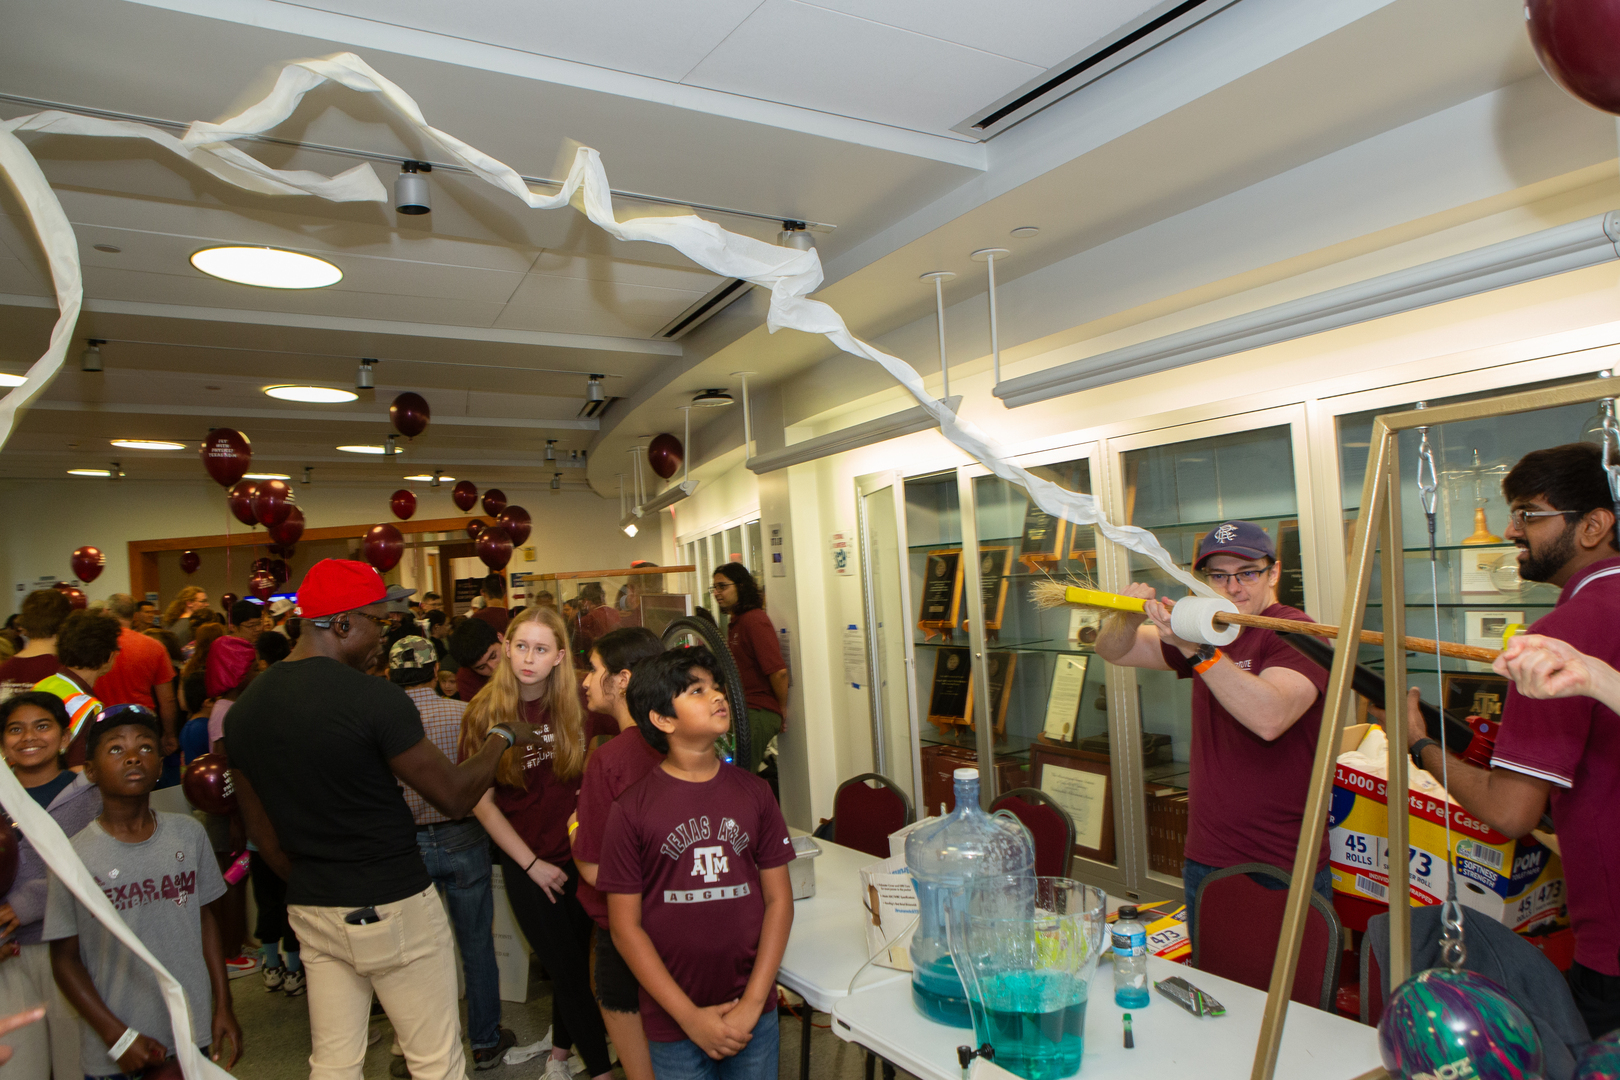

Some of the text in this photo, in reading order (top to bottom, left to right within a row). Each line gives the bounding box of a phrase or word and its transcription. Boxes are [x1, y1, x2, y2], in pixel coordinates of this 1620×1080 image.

[1333, 768, 1374, 791] 1,000
[1453, 811, 1490, 834] Case
[660, 816, 750, 860] TEXAS A&M
[1345, 834, 1367, 853] 45
[1345, 852, 1373, 866] ROLLS
[1514, 851, 1542, 872] POM
[1462, 868, 1495, 889] STRENGTH
[1463, 860, 1498, 881] SOFTNESS
[103, 878, 156, 902] EXAS
[162, 870, 196, 893] A&M
[1417, 876, 1432, 888] ROLL
[1538, 880, 1562, 902] 473
[670, 886, 748, 901] AGGIES
[1519, 896, 1532, 912] 45
[1516, 910, 1532, 923] ROLLS
[1150, 930, 1181, 944] 473
[1411, 1056, 1474, 1080] ZON
